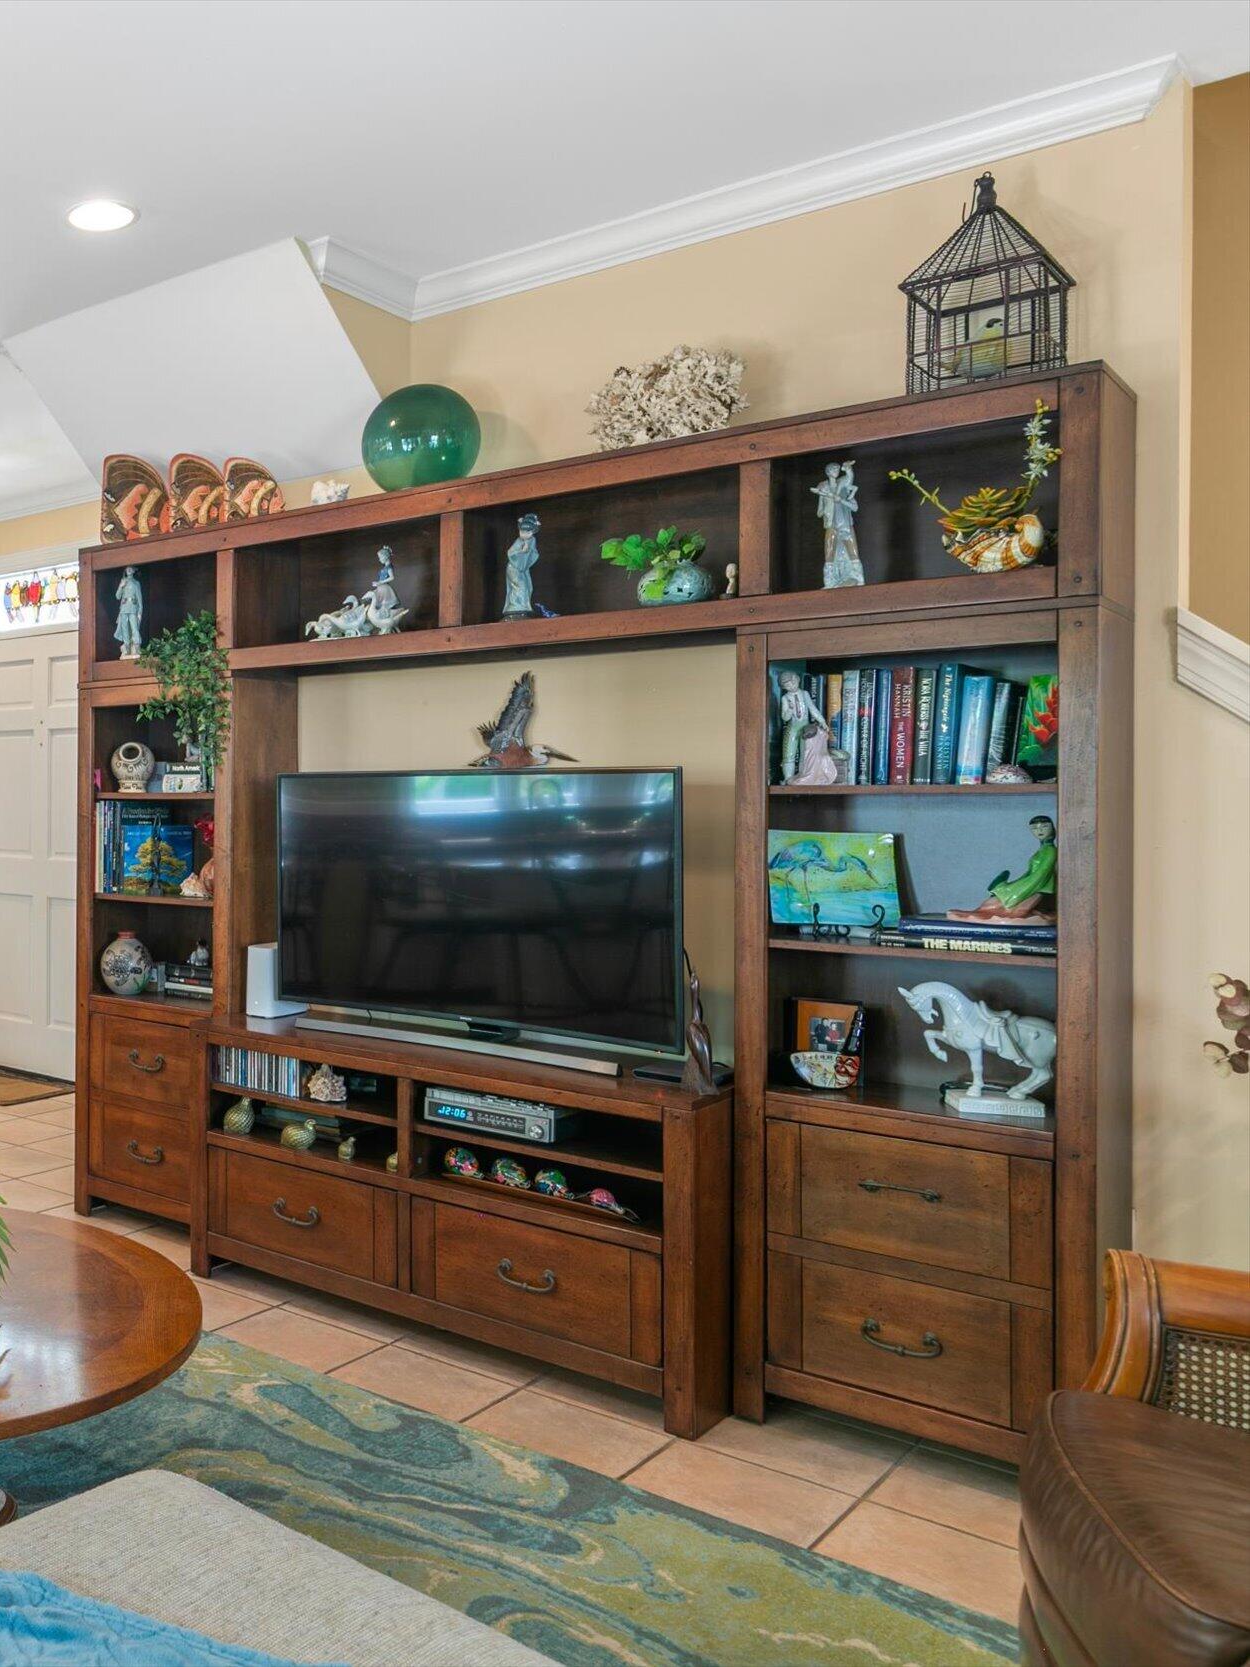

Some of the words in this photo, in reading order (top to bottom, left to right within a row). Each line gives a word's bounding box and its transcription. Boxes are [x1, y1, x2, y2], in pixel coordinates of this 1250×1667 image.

[945, 674, 953, 685] The
[894, 683, 902, 719] HANNAH
[902, 684, 911, 717] KRISTIN
[941, 687, 951, 722] Nightingale
[895, 732, 905, 768] WOMEN
[922, 938, 948, 950] THE
[949, 940, 1012, 954] MARINES
[438, 1106, 466, 1118] 12:06
